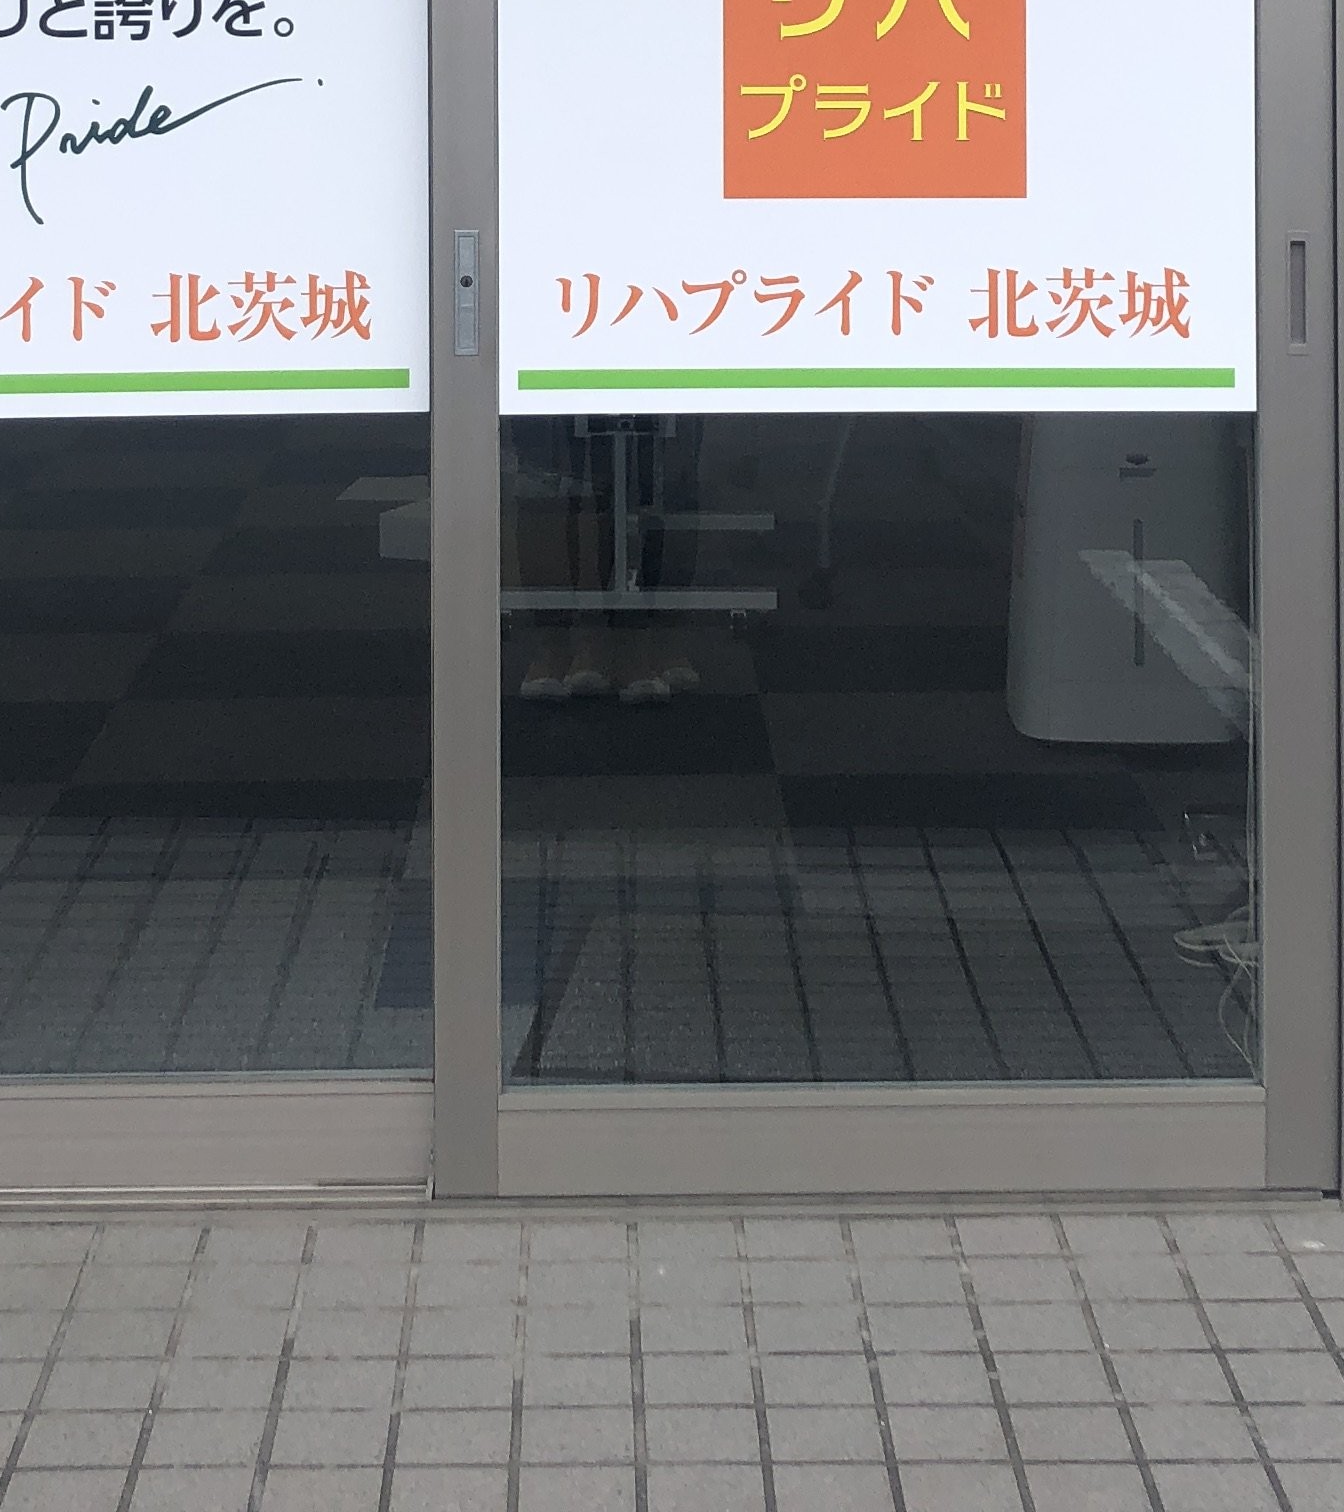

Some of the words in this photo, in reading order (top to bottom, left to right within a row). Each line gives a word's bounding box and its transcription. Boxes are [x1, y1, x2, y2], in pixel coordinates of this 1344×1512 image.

[740, 73, 1007, 142] プライド
[150, 270, 373, 344] 北茨城
[555, 269, 935, 339] リハプライド
[967, 266, 1192, 339] 北茨城
